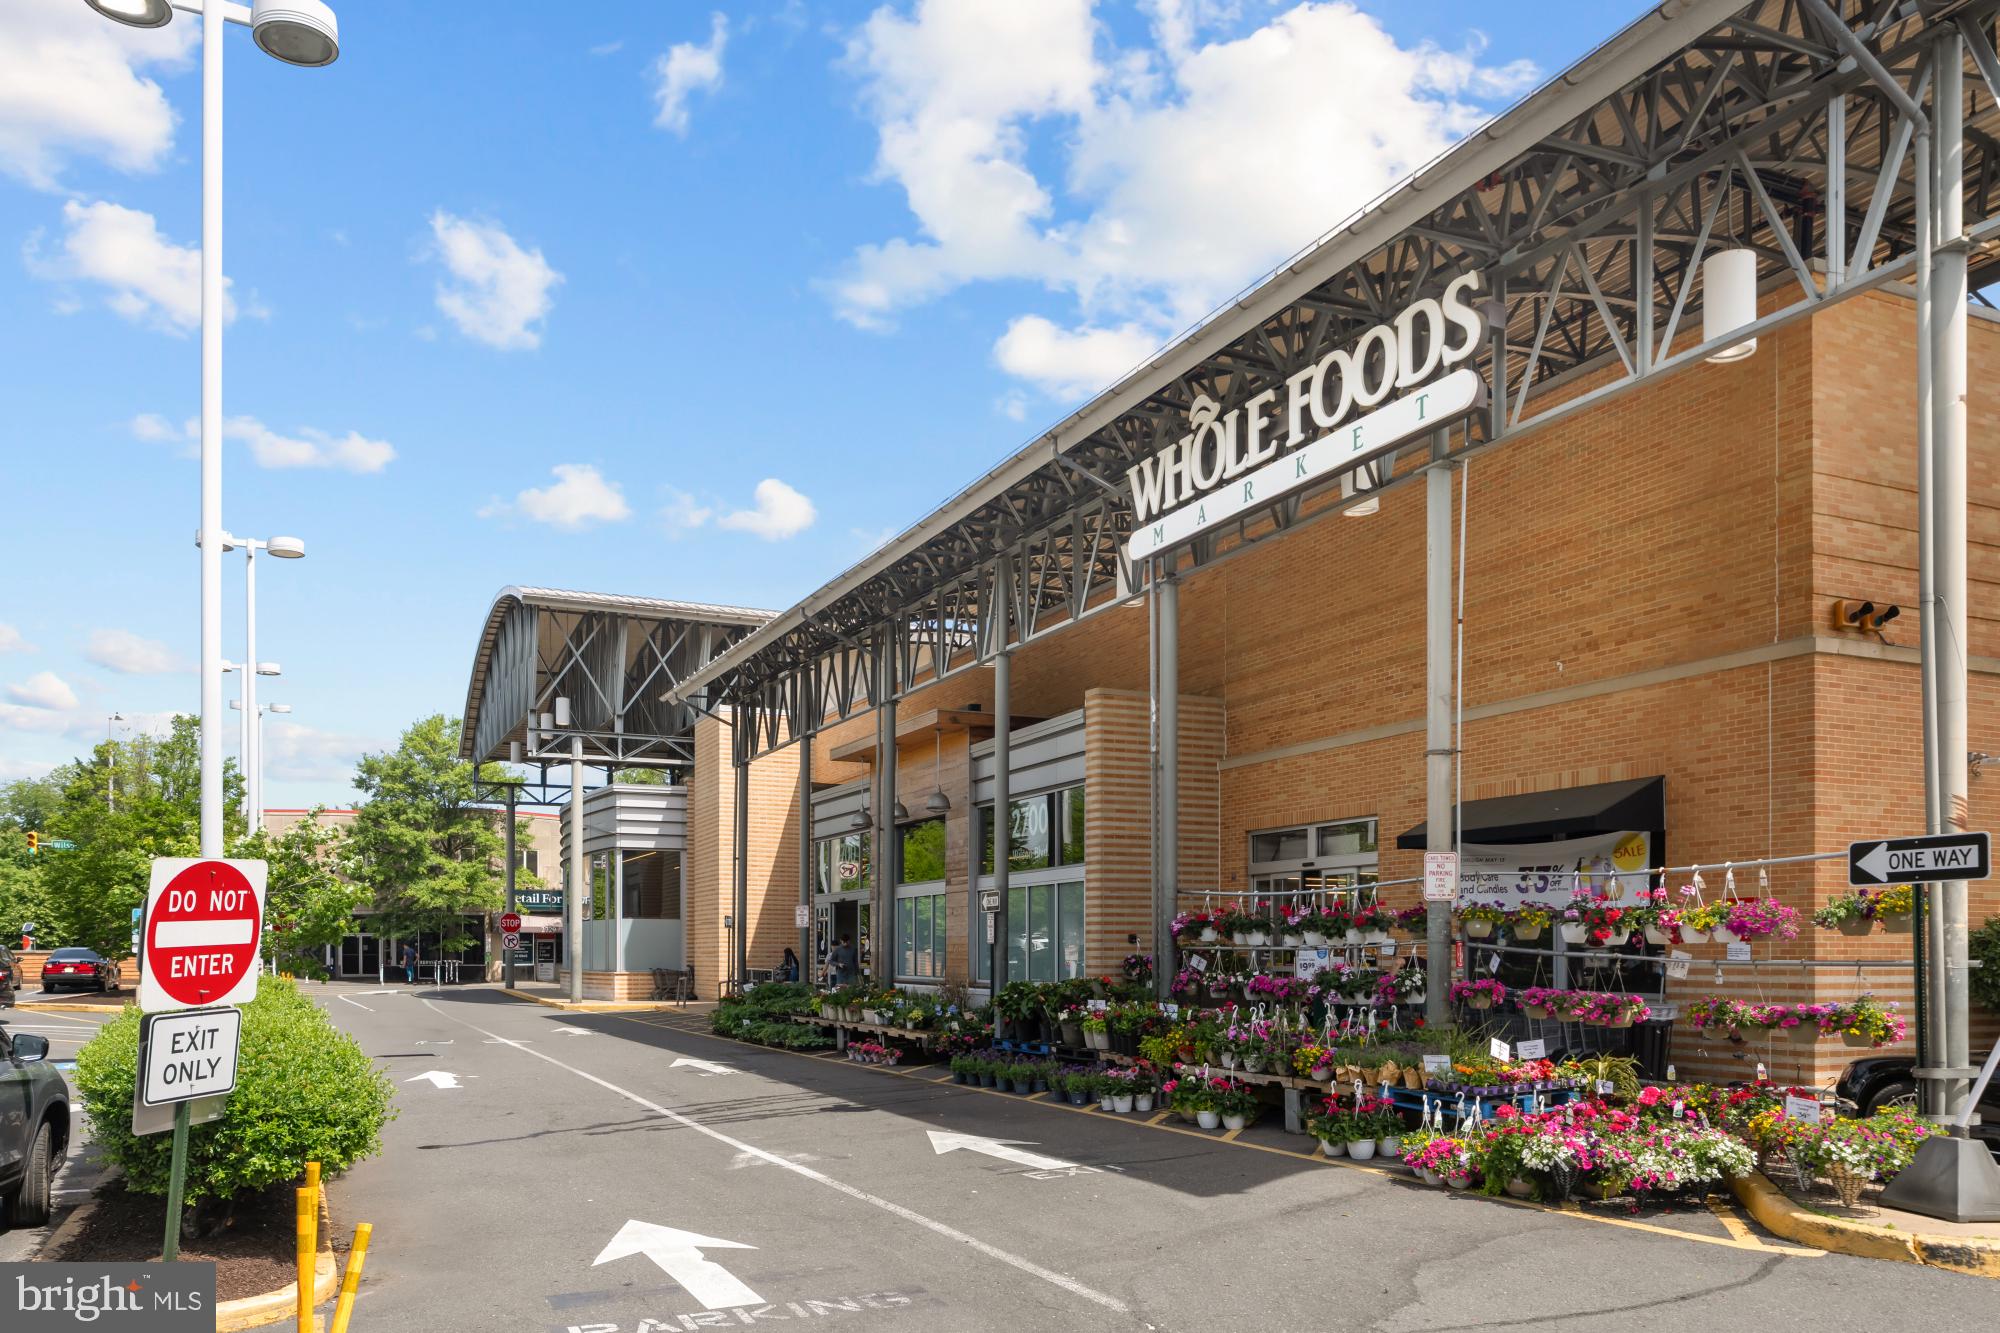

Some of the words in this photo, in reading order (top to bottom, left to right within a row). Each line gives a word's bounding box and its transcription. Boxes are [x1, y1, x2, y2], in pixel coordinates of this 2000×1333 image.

[1126, 389, 1278, 522] WHOLE
[1286, 269, 1484, 449] FOODS
[1152, 394, 1430, 547] MARKET
[1613, 845, 1646, 859] SALE
[1889, 852, 1926, 870] ONE
[1933, 848, 1972, 867] WAY
[168, 889, 197, 913] DO
[209, 889, 248, 912] NOT
[501, 919, 520, 928] STOP
[170, 953, 234, 979] ENTER
[171, 1028, 220, 1055] EXIT
[163, 1056, 222, 1085] ONLY
